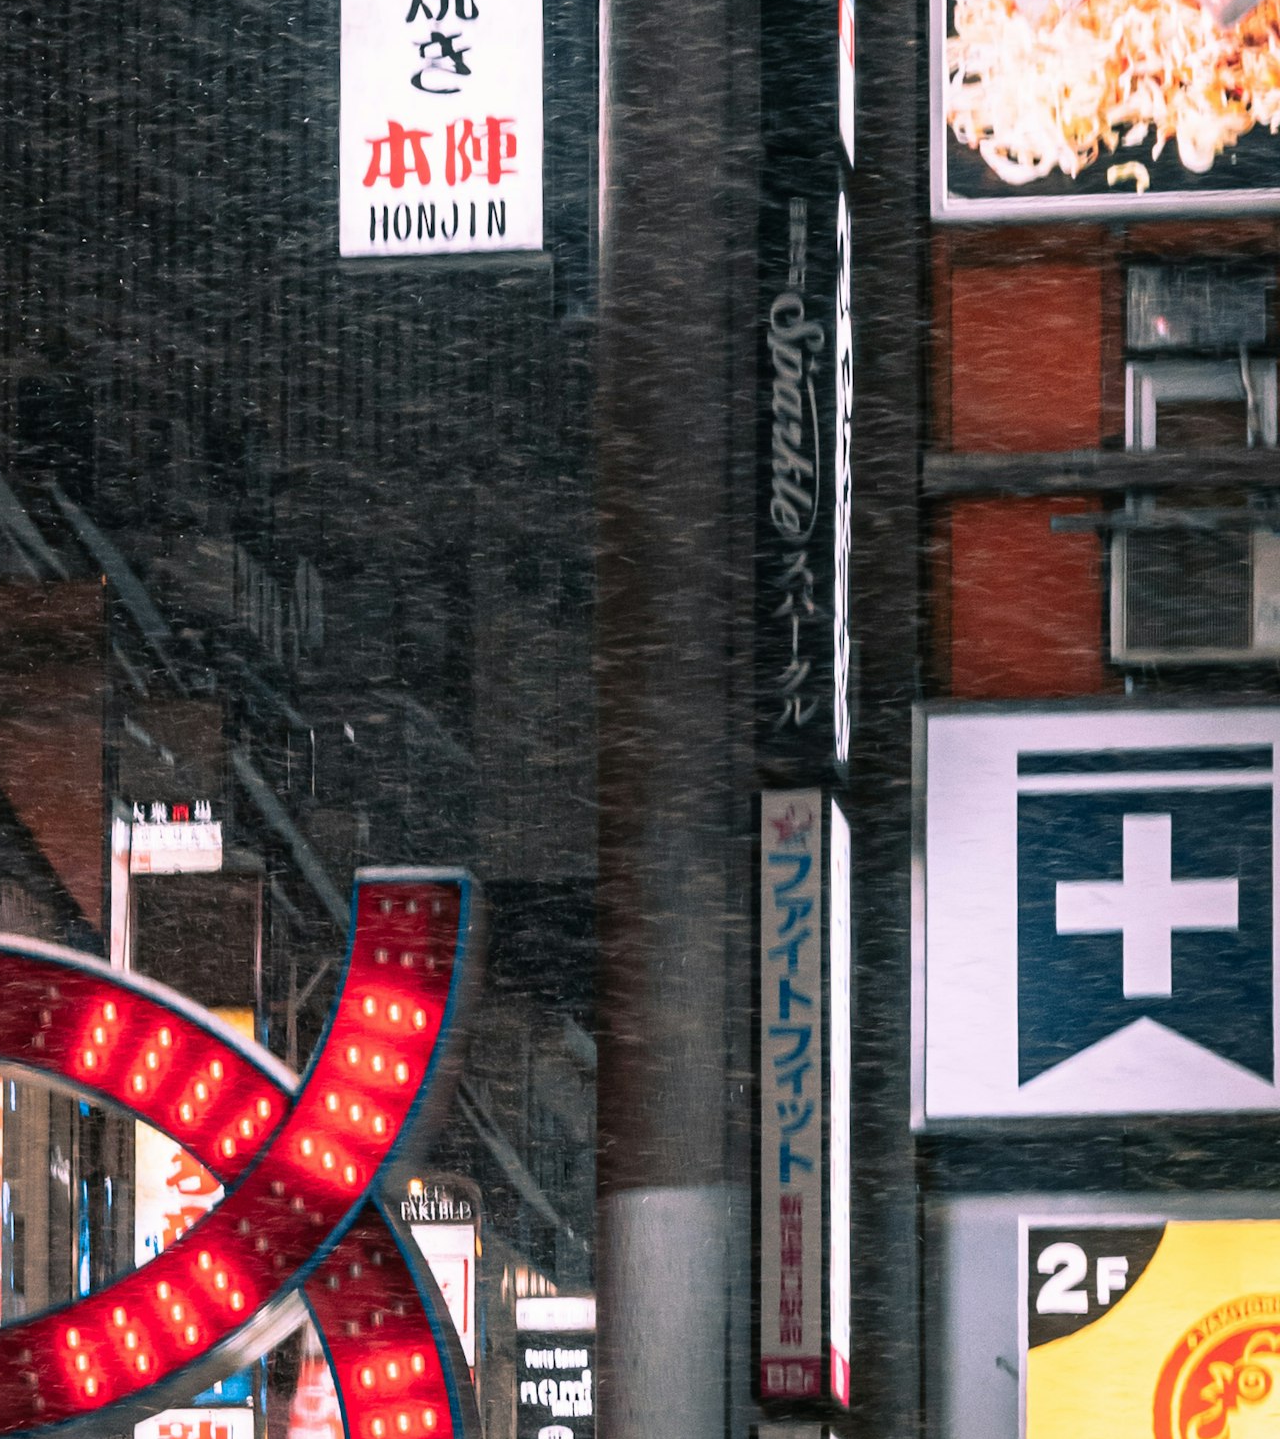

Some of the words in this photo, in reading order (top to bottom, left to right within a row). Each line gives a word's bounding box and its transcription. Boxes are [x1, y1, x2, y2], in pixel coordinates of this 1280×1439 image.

[363, 116, 519, 189] 本陣
[369, 198, 507, 244] HONJIN
[767, 853, 814, 1185] ファイトフィット
[1036, 1241, 1129, 1316] 2F
